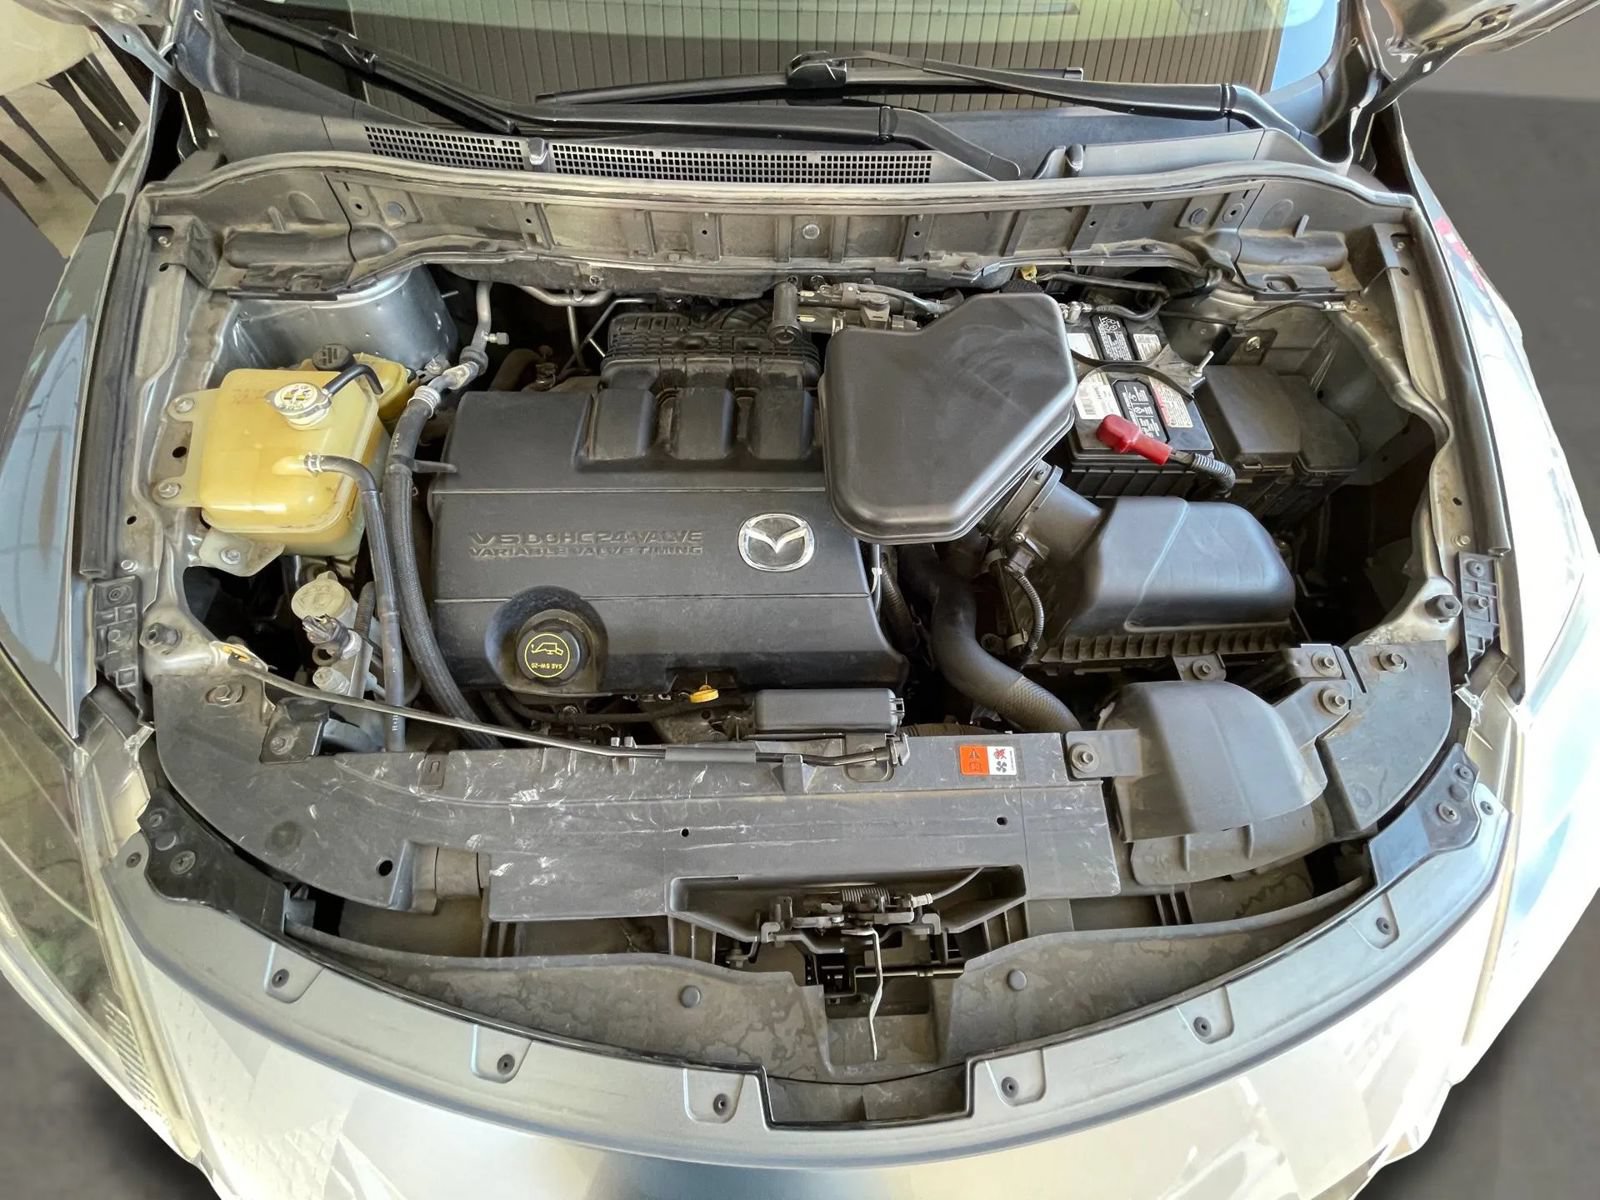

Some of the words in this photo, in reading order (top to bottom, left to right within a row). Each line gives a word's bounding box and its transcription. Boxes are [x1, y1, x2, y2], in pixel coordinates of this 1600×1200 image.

[524, 530, 596, 545] DOHC
[468, 546, 568, 558] VARIABLE
[575, 546, 634, 557] VALVE
[639, 545, 704, 556] TIMING
[530, 662, 551, 670] 5W-20
[551, 662, 563, 670] SAE
